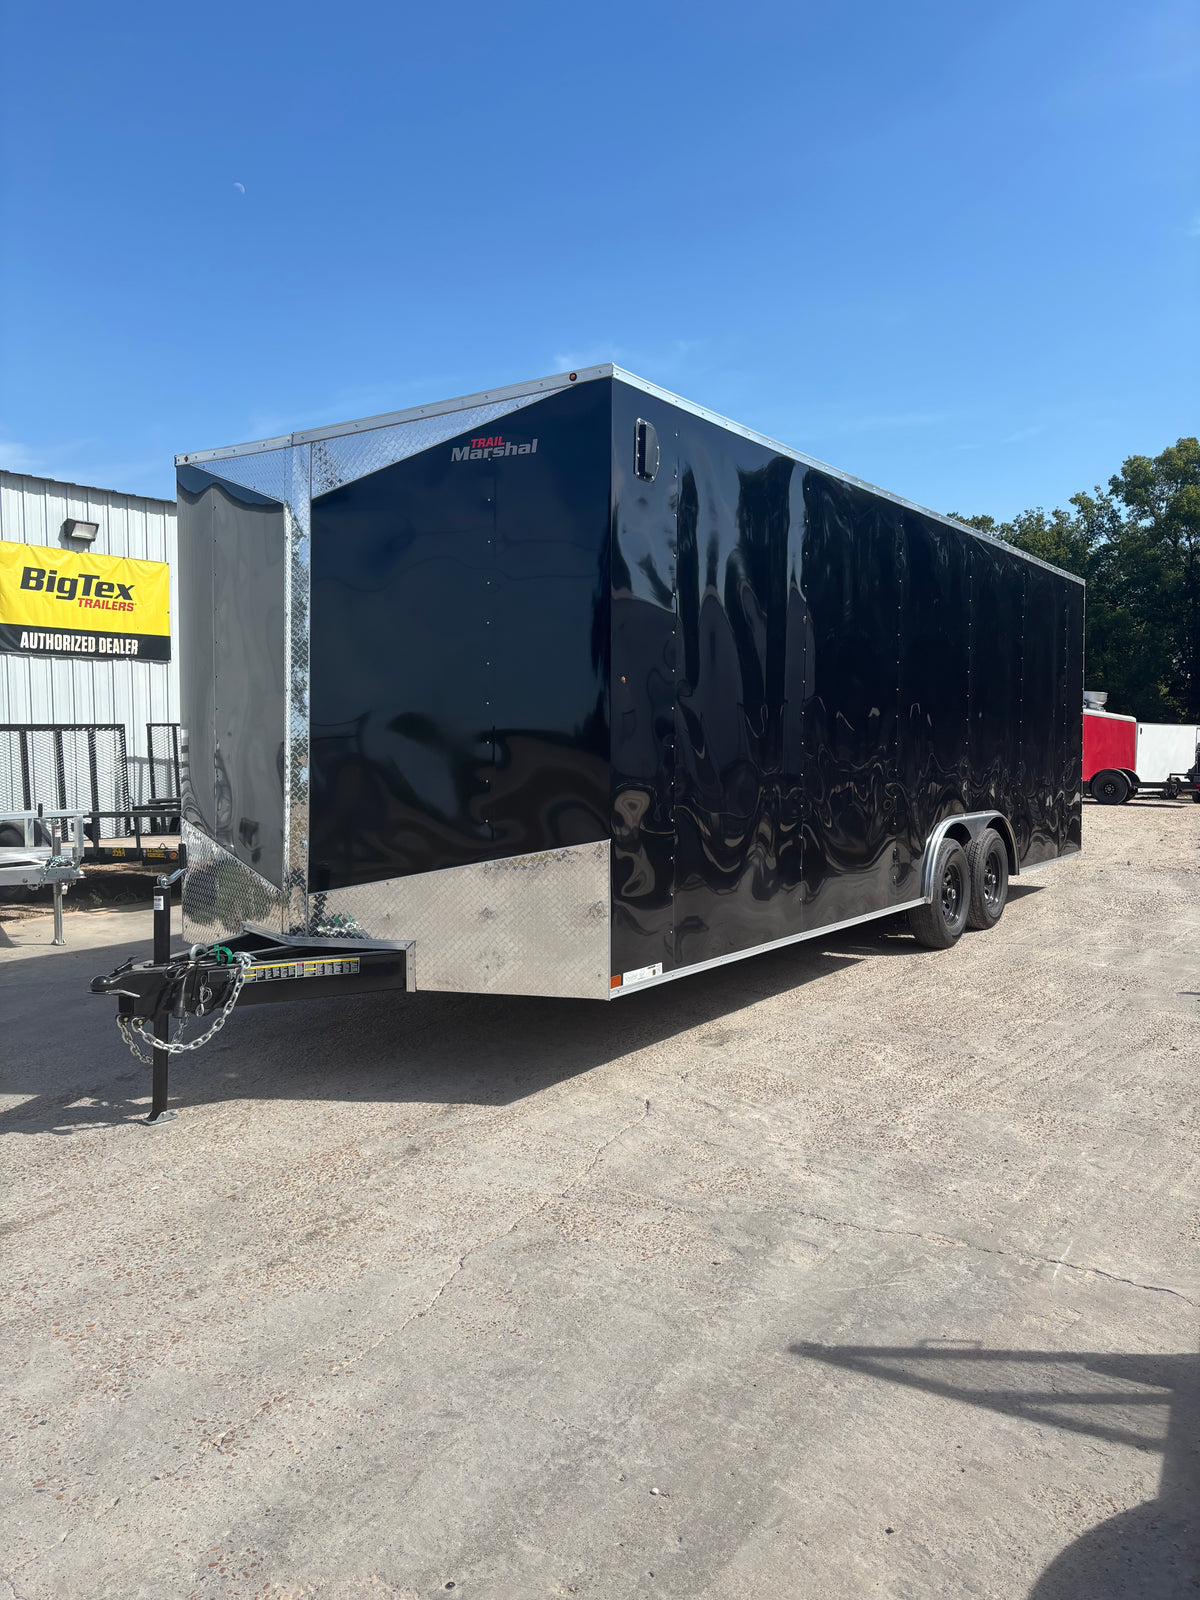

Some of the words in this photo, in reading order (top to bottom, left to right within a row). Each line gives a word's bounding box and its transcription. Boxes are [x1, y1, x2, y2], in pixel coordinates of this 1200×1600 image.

[451, 438, 538, 461] Marshal
[471, 436, 505, 448] TRAIL
[77, 597, 136, 612] TRAILERS
[20, 631, 96, 653] AUTHORIZED
[98, 637, 139, 655] DEALER
